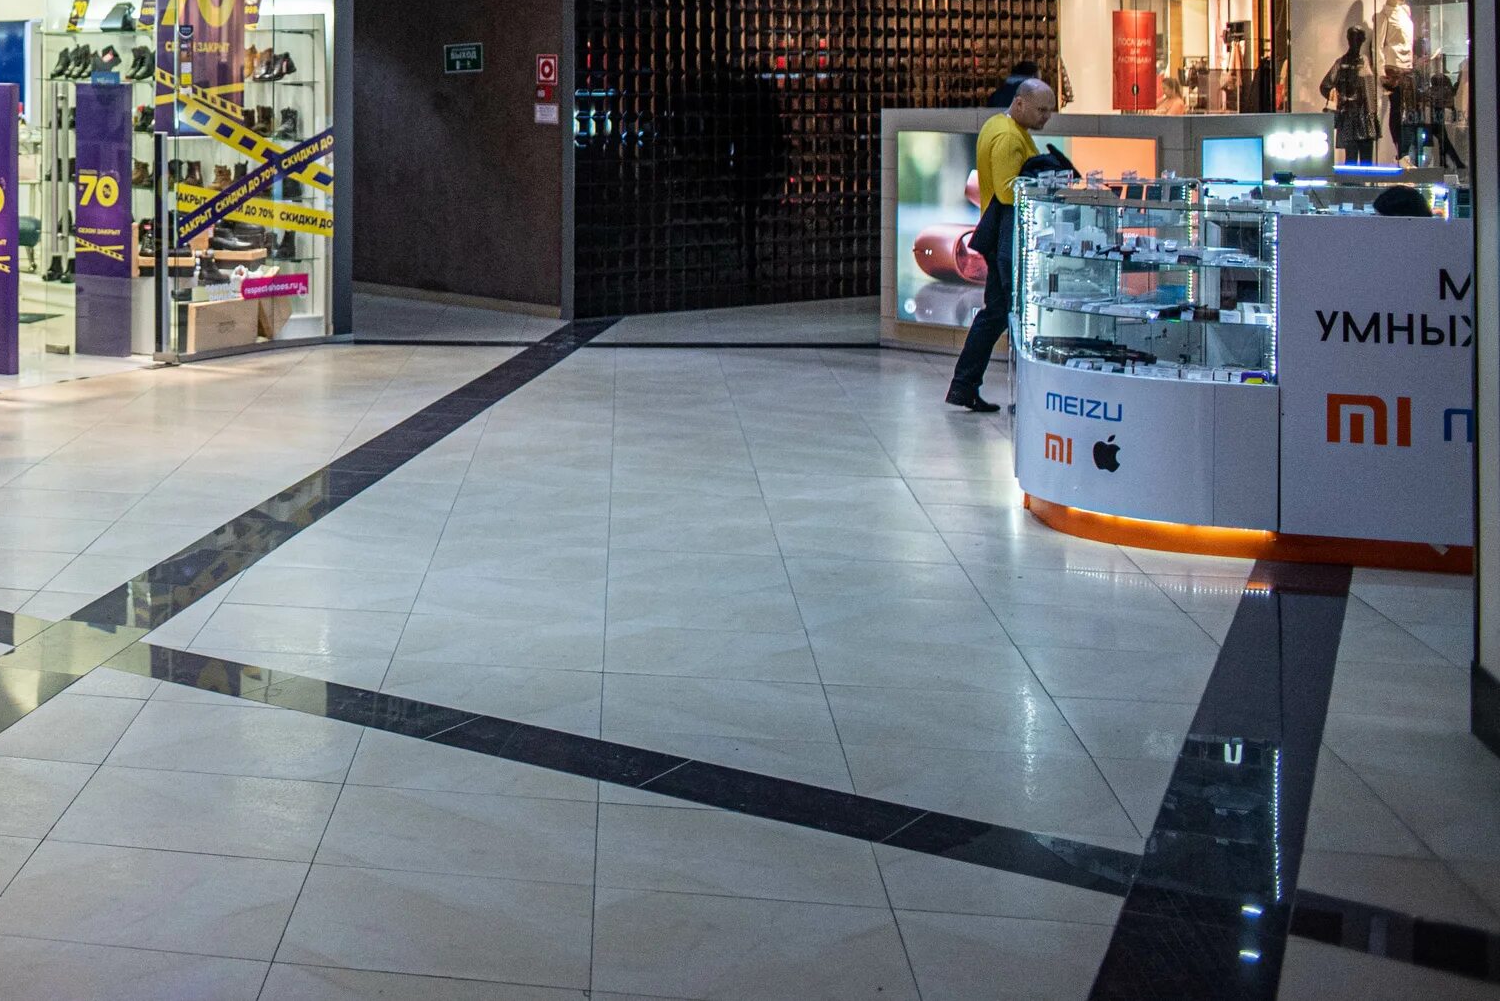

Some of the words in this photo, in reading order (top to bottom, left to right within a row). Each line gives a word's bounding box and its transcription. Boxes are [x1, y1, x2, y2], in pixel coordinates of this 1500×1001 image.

[79, 175, 119, 207] 70
[180, 207, 212, 237] ЗАКРЫТ
[215, 185, 247, 213] СКИДКИ
[248, 177, 260, 193] ДО
[260, 166, 278, 184] 70%
[281, 142, 319, 169] СКИДКИ
[319, 135, 334, 150] ДО
[245, 204, 257, 216] ДО
[258, 207, 274, 219] 70%
[280, 211, 317, 226] СКИДКИ
[318, 216, 333, 229] ДО
[244, 282, 298, 295] respect-shoes.ru
[1046, 392, 1122, 422] MEIZU
